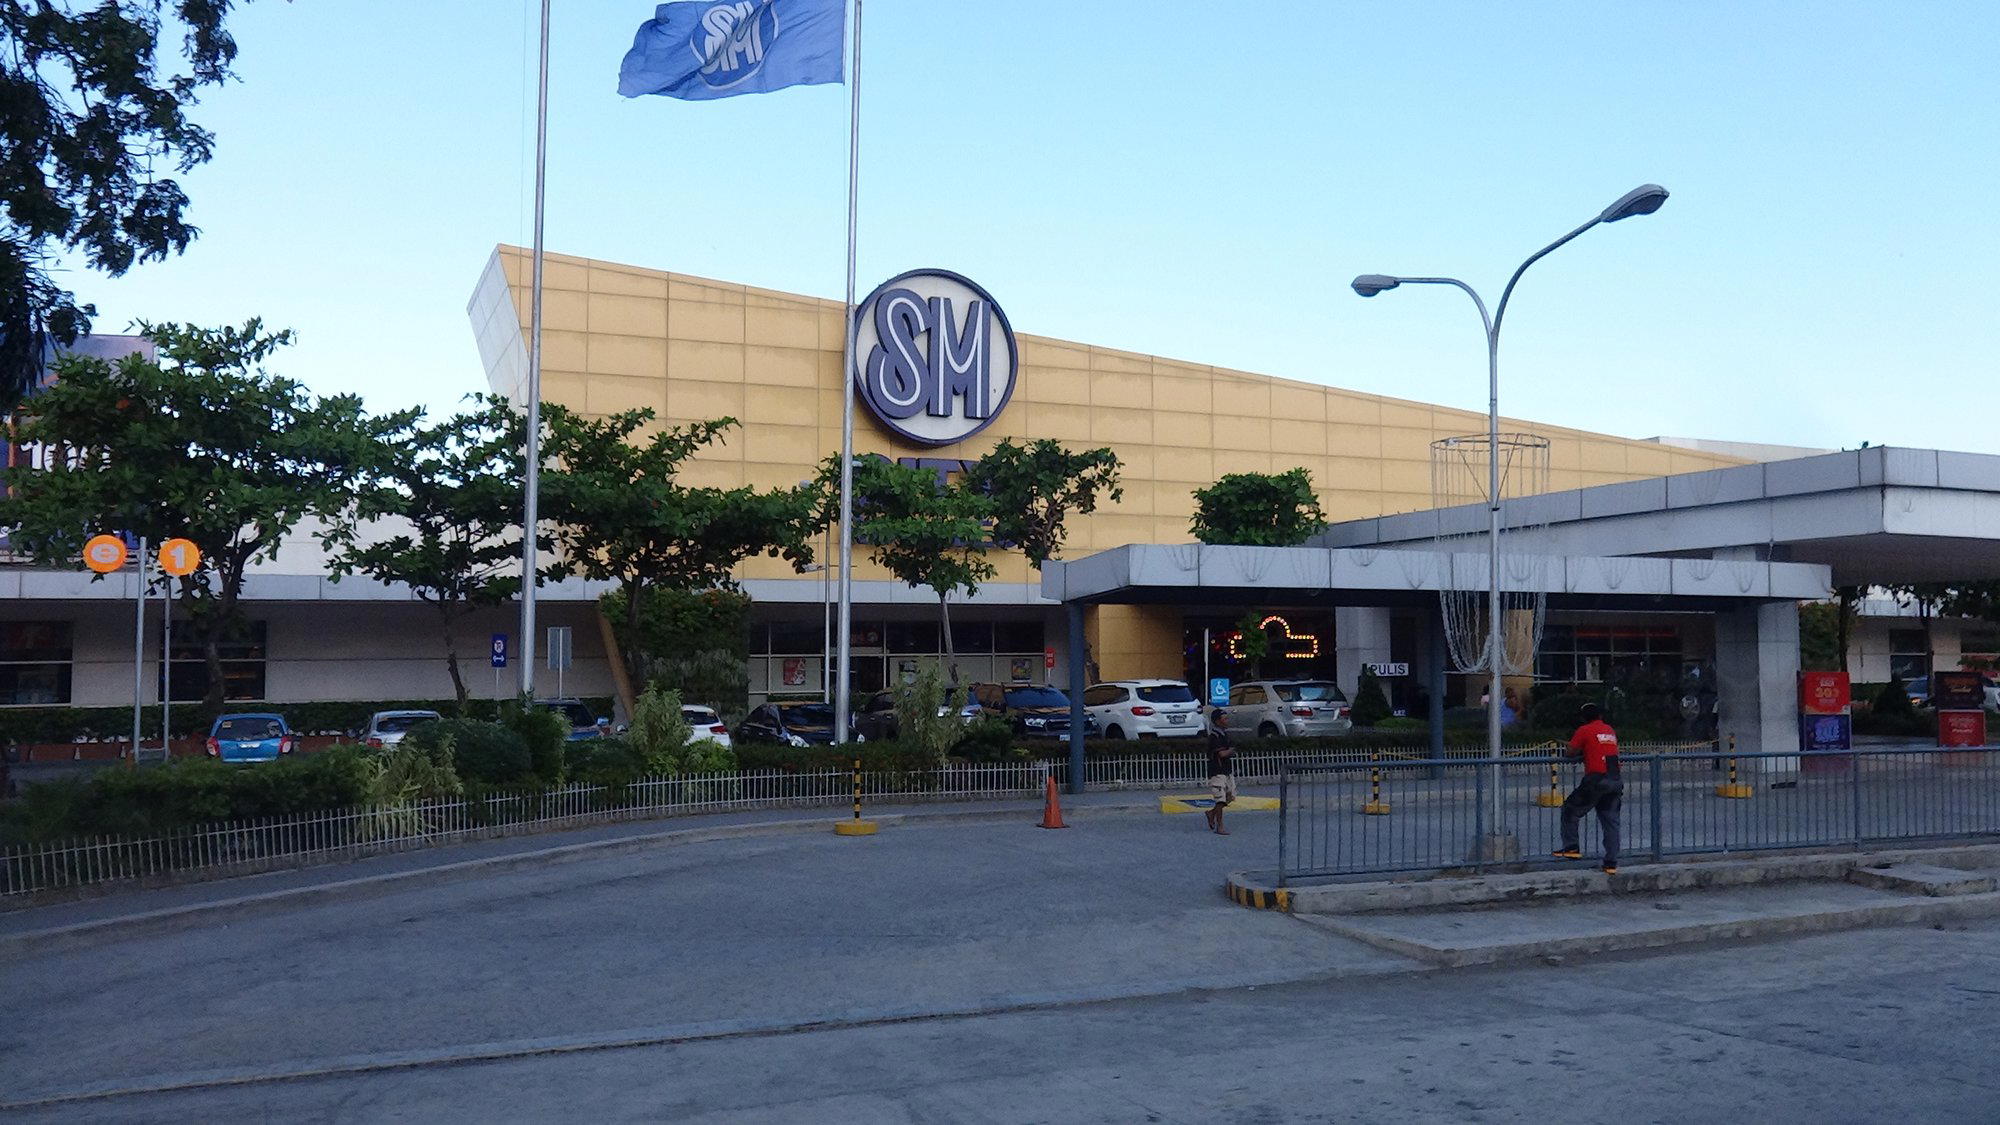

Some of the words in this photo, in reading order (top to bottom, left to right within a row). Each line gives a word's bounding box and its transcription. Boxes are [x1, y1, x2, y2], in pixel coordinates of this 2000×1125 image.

[701, 1, 763, 74] SM
[866, 288, 992, 420] SM
[169, 543, 188, 569] 1
